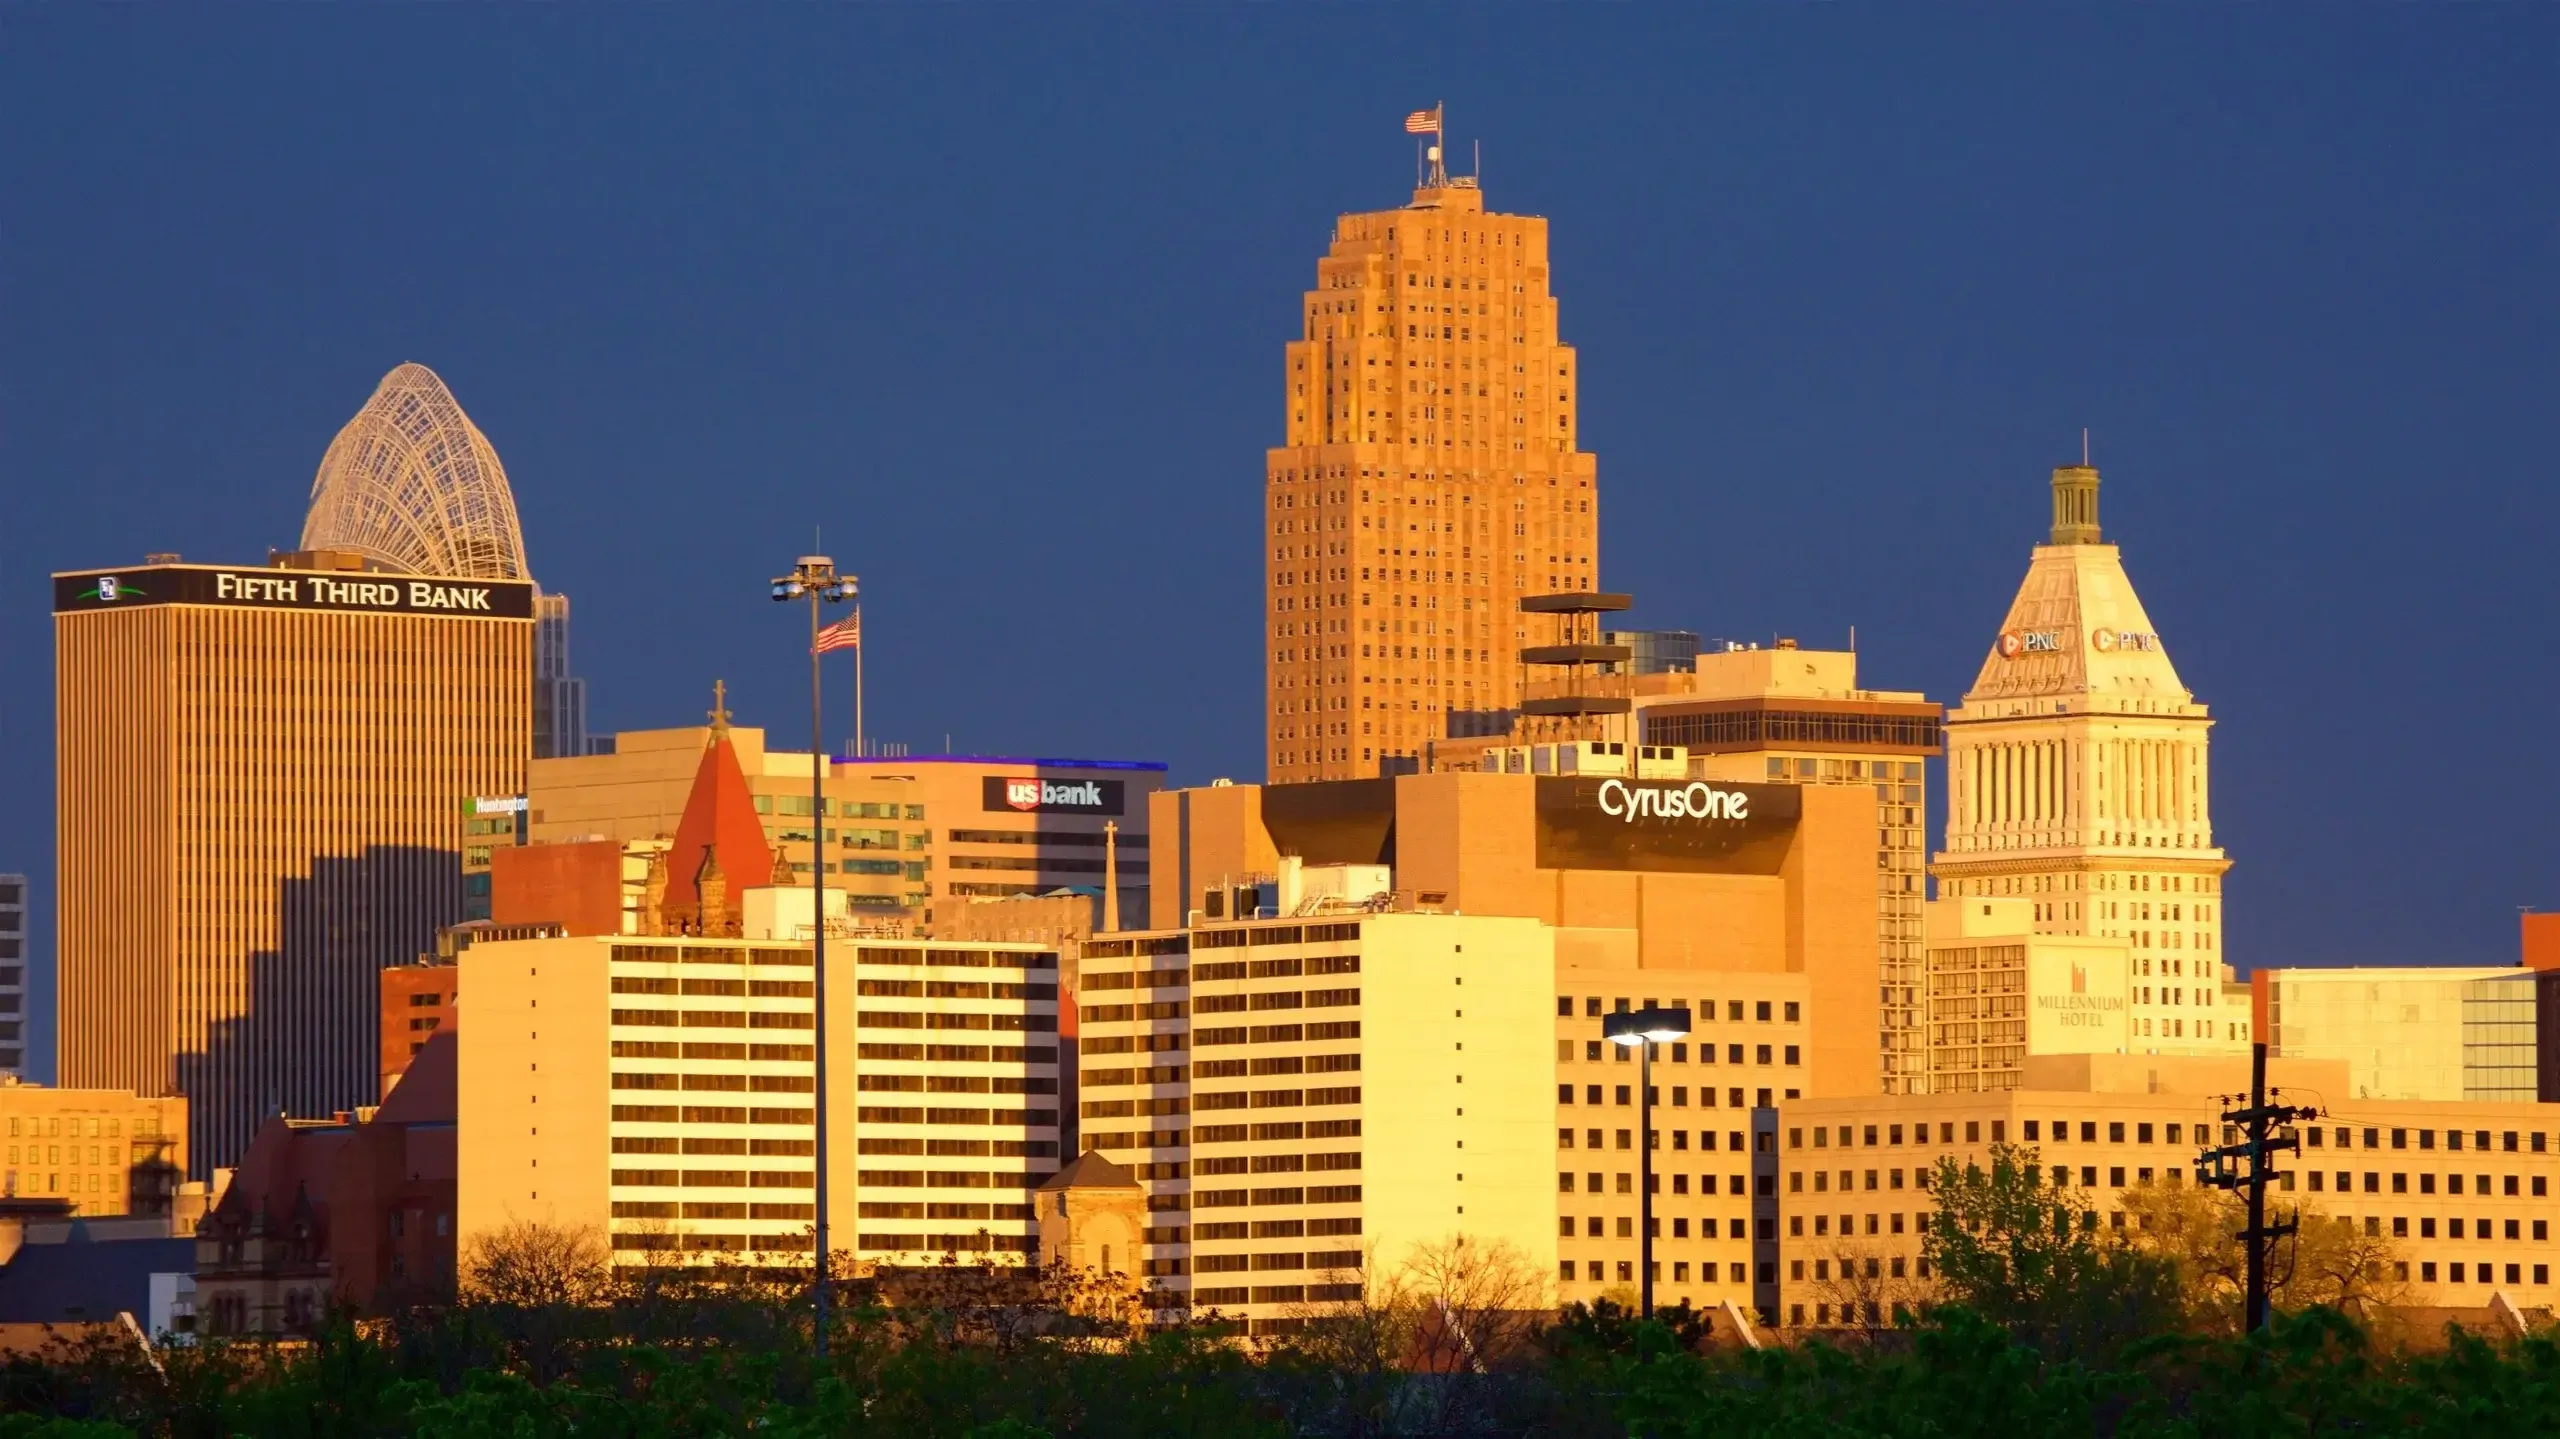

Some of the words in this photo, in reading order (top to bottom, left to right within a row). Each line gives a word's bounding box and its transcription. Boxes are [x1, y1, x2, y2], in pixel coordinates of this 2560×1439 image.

[2023, 631, 2060, 652] PNC
[2119, 631, 2158, 652] PNC
[1598, 779, 1748, 823] CyrusOne
[2037, 995, 2123, 1011] MILLENNIUM
[2060, 1012, 2104, 1027] HOTEL
